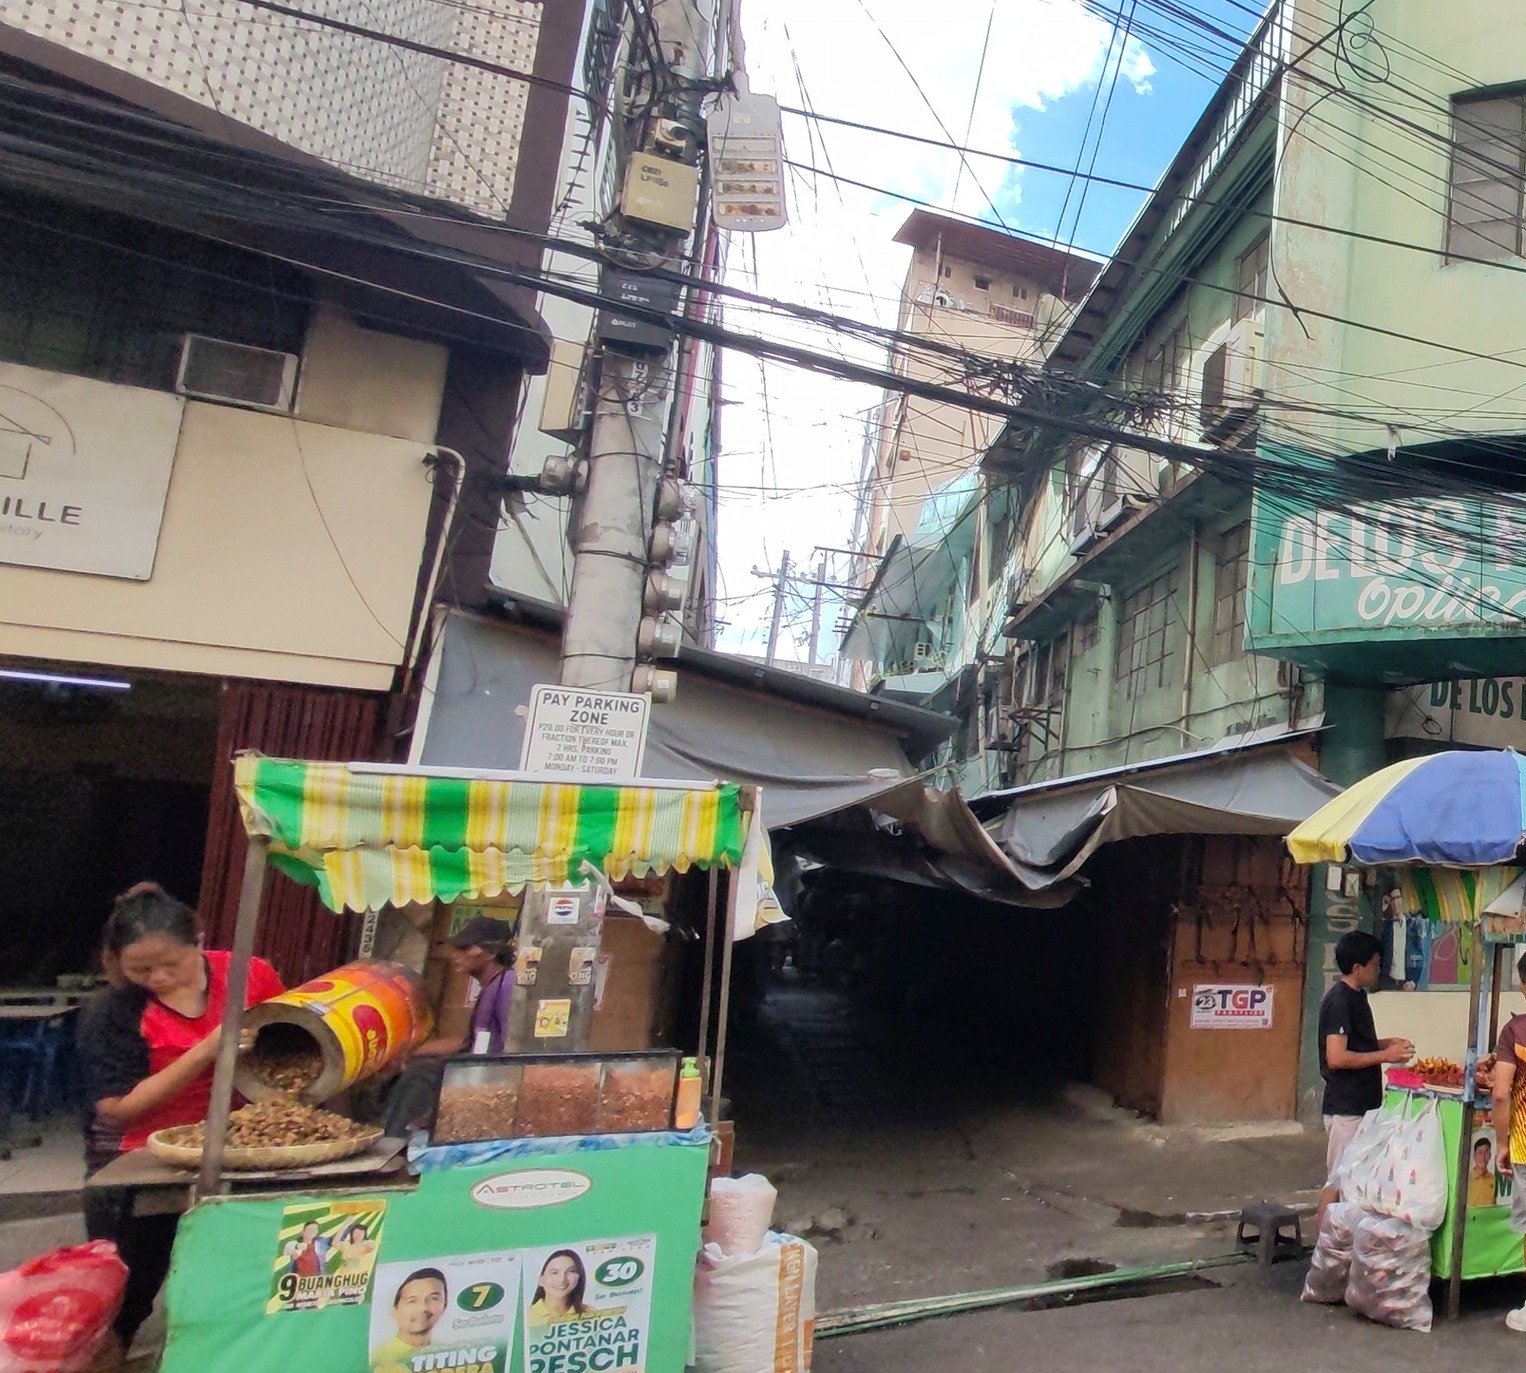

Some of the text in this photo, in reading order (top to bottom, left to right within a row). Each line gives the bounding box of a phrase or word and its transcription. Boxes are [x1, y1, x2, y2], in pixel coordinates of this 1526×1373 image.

[2, 496, 82, 526] ILLE
[1280, 508, 1342, 585] DE
[1350, 500, 1468, 578] LOS
[543, 692, 640, 714] PAY PARKING
[1430, 679, 1462, 711] DE
[1469, 678, 1514, 719] LOS
[570, 710, 609, 726] ZONE
[541, 732, 576, 743] FRACTION
[566, 725, 579, 734] FOR
[581, 725, 604, 736] EVERY
[606, 728, 624, 738] HOUR
[625, 730, 635, 739] OR
[557, 744, 562, 752] 2
[581, 746, 612, 756] PARKING
[565, 754, 577, 763] AM
[579, 755, 588, 764] TO
[607, 758, 618, 766] PM
[545, 762, 575, 772] MONDAY
[581, 765, 618, 776] SATURDAY
[1217, 989, 1267, 1010] TGP
[476, 1181, 585, 1196] ASTROTEL
[603, 1261, 638, 1283] 30
[279, 1272, 368, 1302] 9 BUANGHUG
[472, 1284, 492, 1309] 7
[544, 1315, 627, 1340] JESSICA
[529, 1328, 640, 1356] PONTANAR
[411, 1345, 498, 1372] TITING
